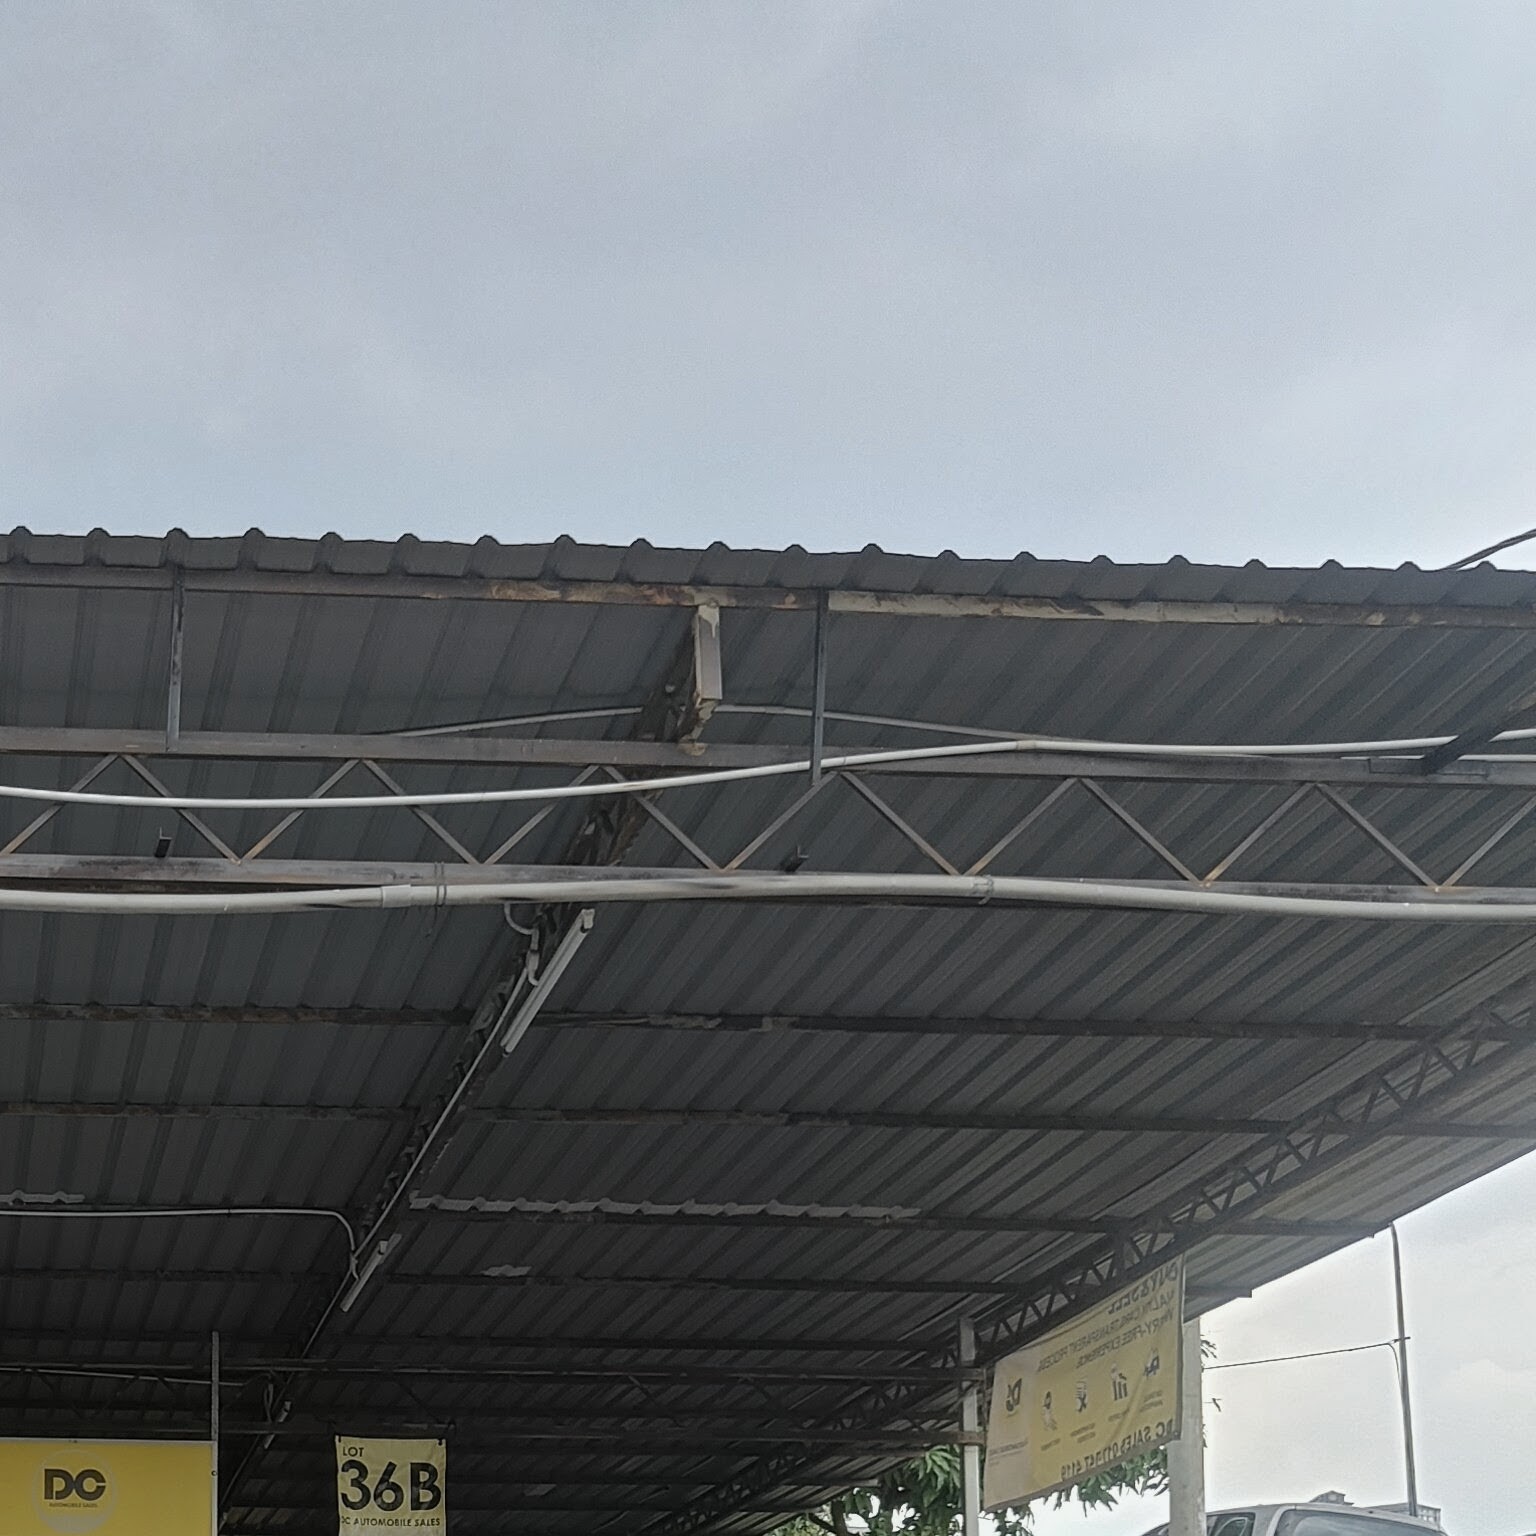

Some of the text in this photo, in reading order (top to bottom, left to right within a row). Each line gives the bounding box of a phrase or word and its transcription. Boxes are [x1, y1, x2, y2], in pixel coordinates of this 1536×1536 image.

[342, 1446, 364, 1457] LOT
[44, 1468, 106, 1501] DC
[341, 1459, 441, 1511] 36B
[353, 1517, 411, 1526] AUTOMOBILE
[414, 1518, 440, 1526] SALES
